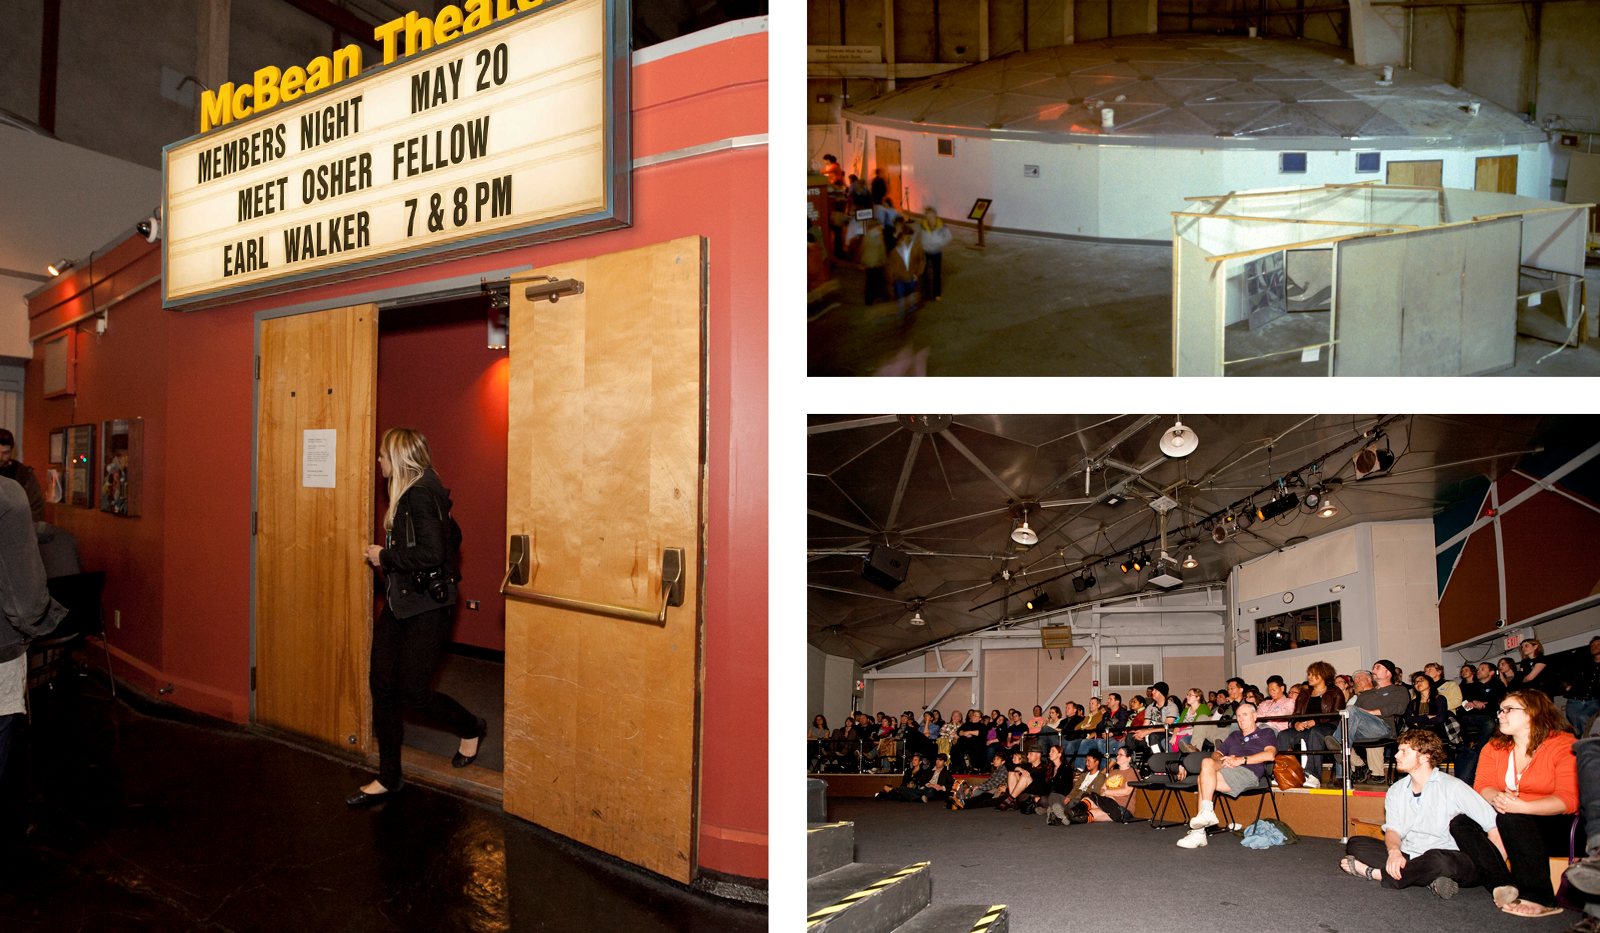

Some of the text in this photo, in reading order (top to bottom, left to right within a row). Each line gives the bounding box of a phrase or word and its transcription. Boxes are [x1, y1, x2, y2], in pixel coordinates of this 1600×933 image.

[198, 42, 509, 184] MEMBERS NIGHT MAY 20
[200, 0, 551, 133] McBean Thea
[237, 116, 490, 223] MEET OSHER FELLOW
[223, 236, 269, 278] EARL
[283, 211, 371, 264] WALKER
[404, 199, 418, 237] 7
[428, 192, 445, 233] &
[1507, 635, 1518, 648] EXIT
